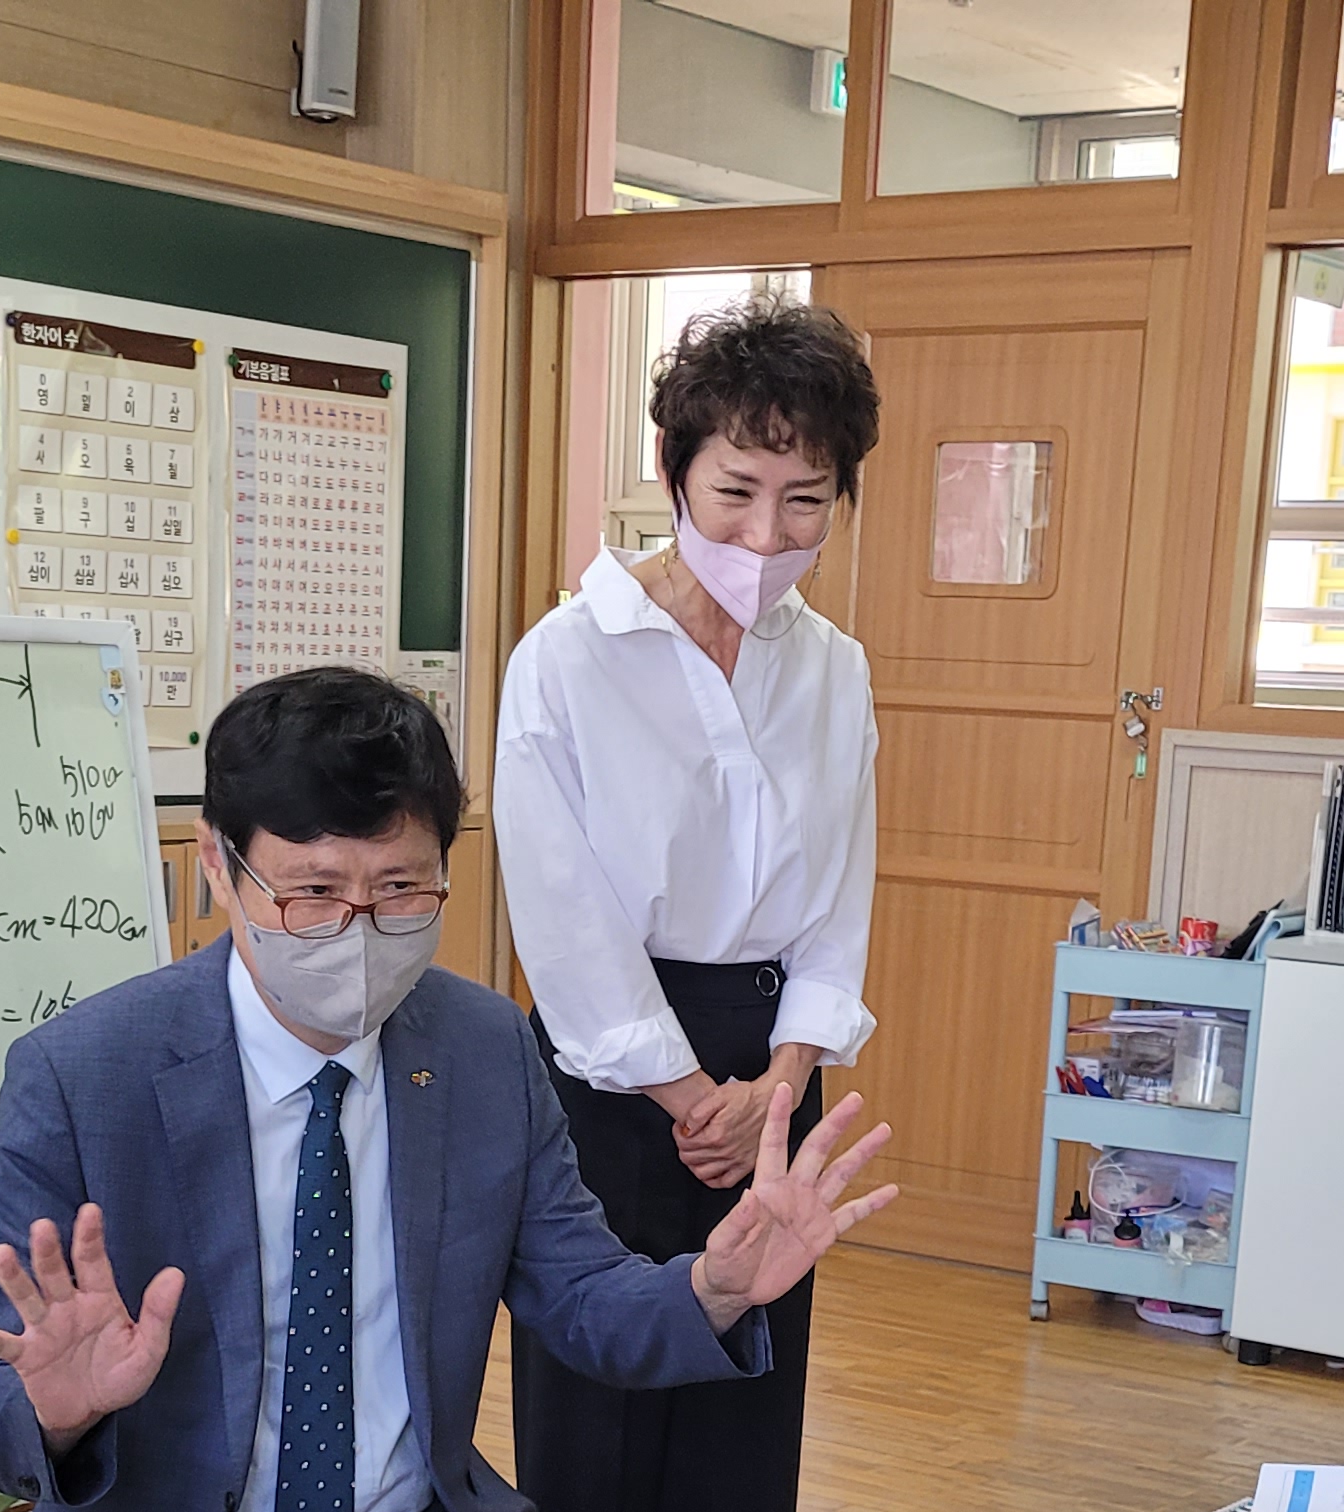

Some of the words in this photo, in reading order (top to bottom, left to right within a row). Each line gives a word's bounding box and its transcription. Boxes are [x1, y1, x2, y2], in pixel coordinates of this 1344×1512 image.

[21, 322, 62, 346] 한자어
[64, 329, 79, 349] 수
[40, 373, 46, 385] 0
[128, 386, 134, 398] 2
[124, 400, 135, 418] 이
[168, 406, 180, 423] 삼
[82, 438, 88, 450] 5
[36, 450, 45, 465] 사
[79, 453, 91, 469] 오
[124, 457, 135, 476] 육
[124, 501, 136, 513] 10
[168, 506, 178, 517] 11
[79, 511, 91, 528] 구
[125, 515, 135, 532] 십
[163, 519, 183, 537] 십일
[34, 551, 46, 563] 12
[80, 555, 91, 566] 13
[123, 558, 135, 570] 14
[28, 565, 50, 583] 십이
[167, 561, 177, 572] 15
[74, 568, 96, 586] 십삼
[118, 571, 140, 590] 십사
[162, 576, 183, 591] 십오
[164, 630, 183, 647] 십구
[167, 685, 178, 700] 만
